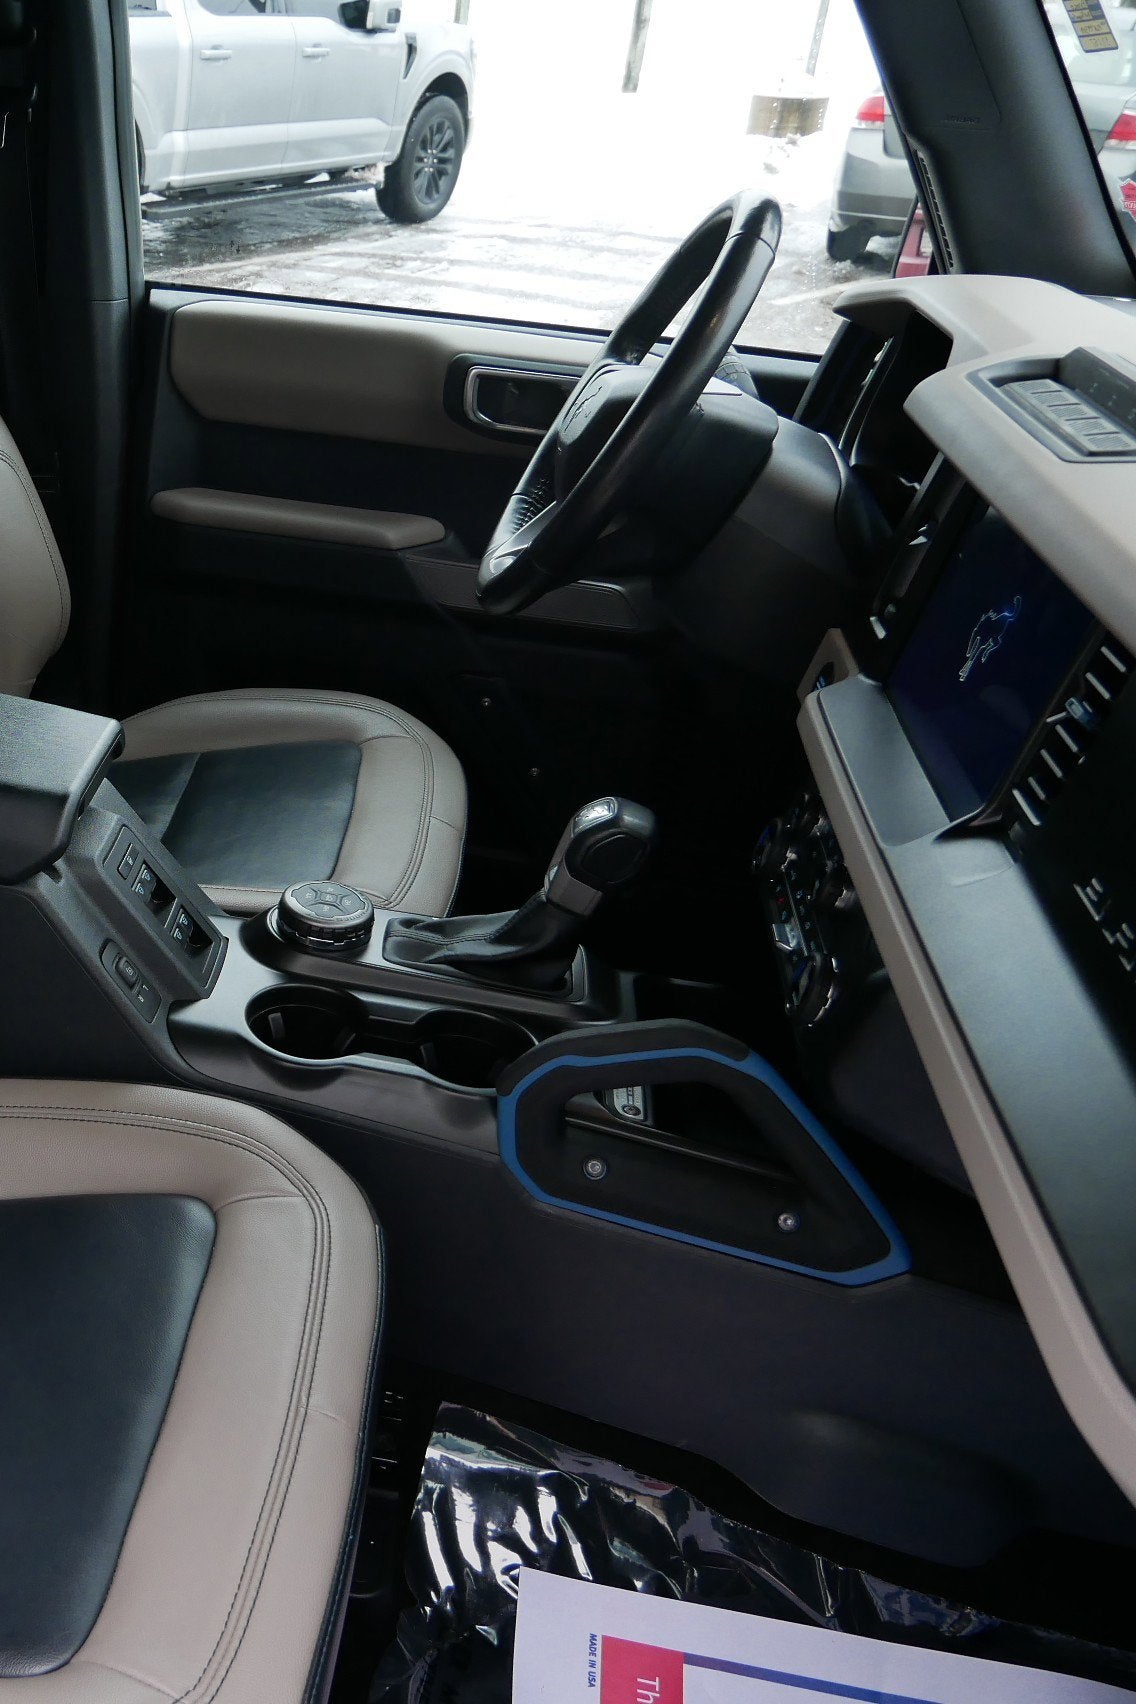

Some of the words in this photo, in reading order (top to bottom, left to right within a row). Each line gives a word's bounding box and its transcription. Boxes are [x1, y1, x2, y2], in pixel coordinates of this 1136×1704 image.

[588, 1633, 598, 1657] MADE
[588, 1659, 597, 1669] IN
[587, 1671, 597, 1688] USA
